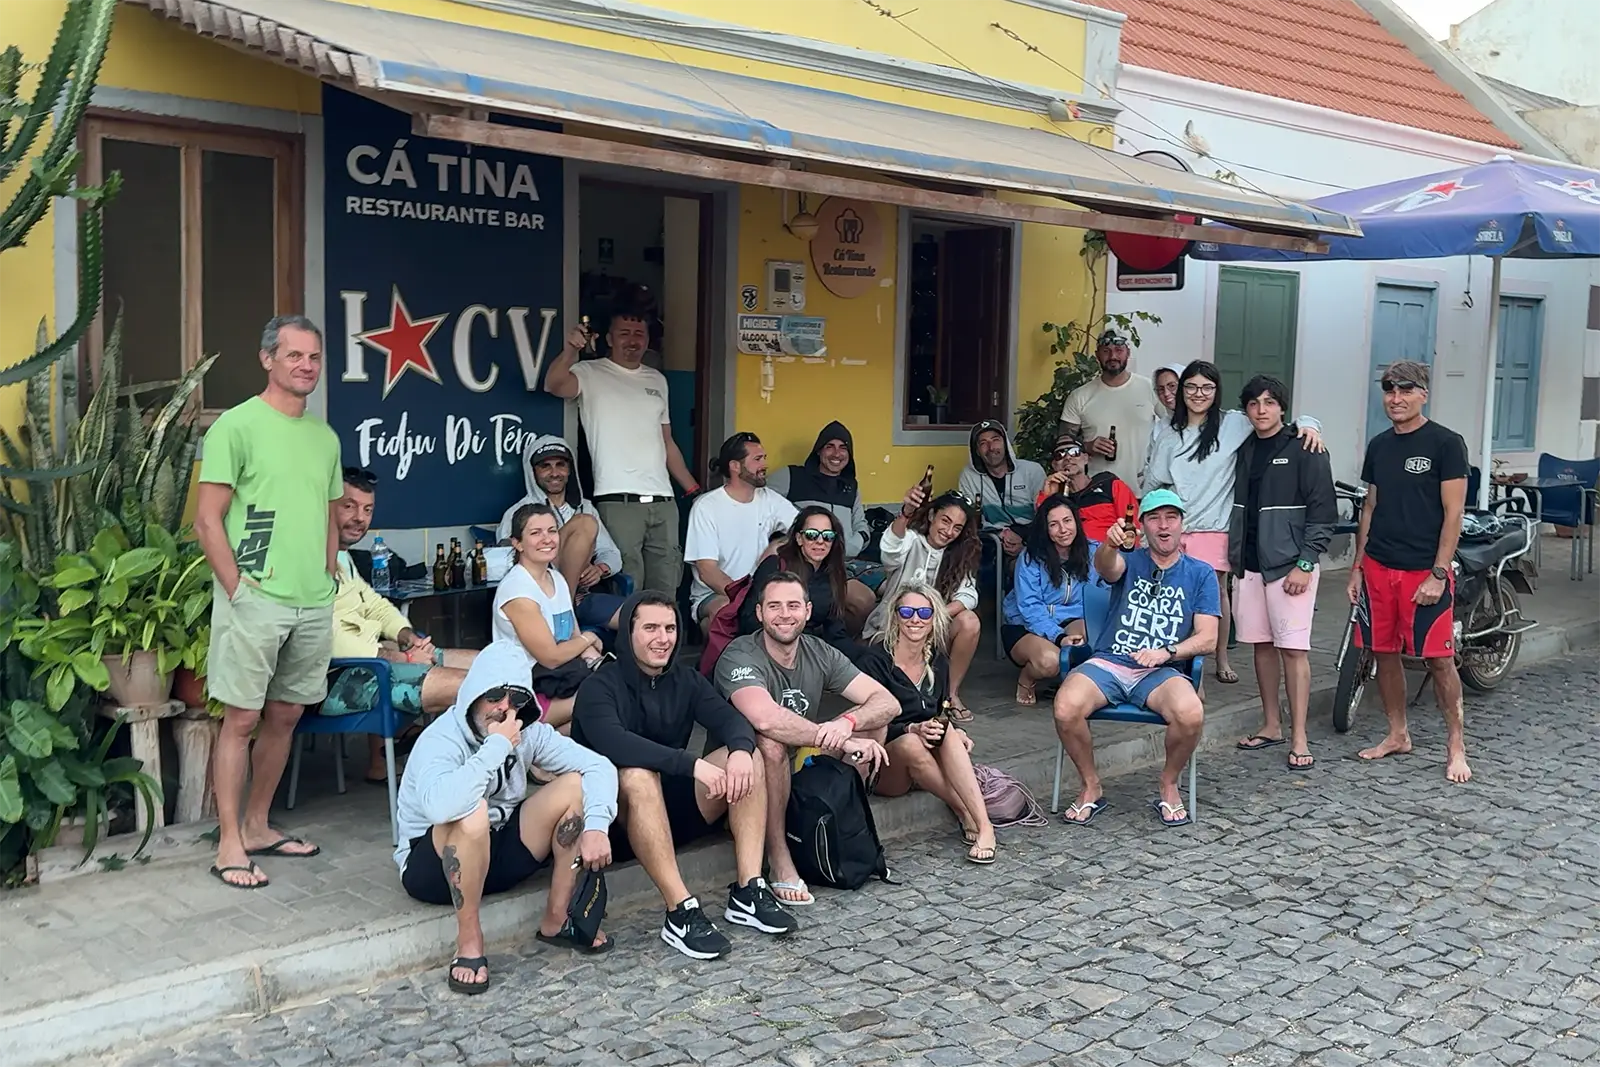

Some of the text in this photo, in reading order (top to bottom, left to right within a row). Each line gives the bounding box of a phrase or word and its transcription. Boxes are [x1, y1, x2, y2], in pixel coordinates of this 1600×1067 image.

[346, 139, 540, 201] CÁ TINA
[346, 196, 545, 230] RESTAURANTE BAR
[743, 318, 779, 330] HIGIENE
[741, 332, 769, 342] ALCOOL
[748, 343, 763, 351] GEL
[445, 415, 488, 465] Di
[1406, 459, 1429, 471] DEUS
[1133, 576, 1186, 600] JERCOA
[1128, 589, 1184, 616] COARA
[1121, 604, 1184, 642] JERI
